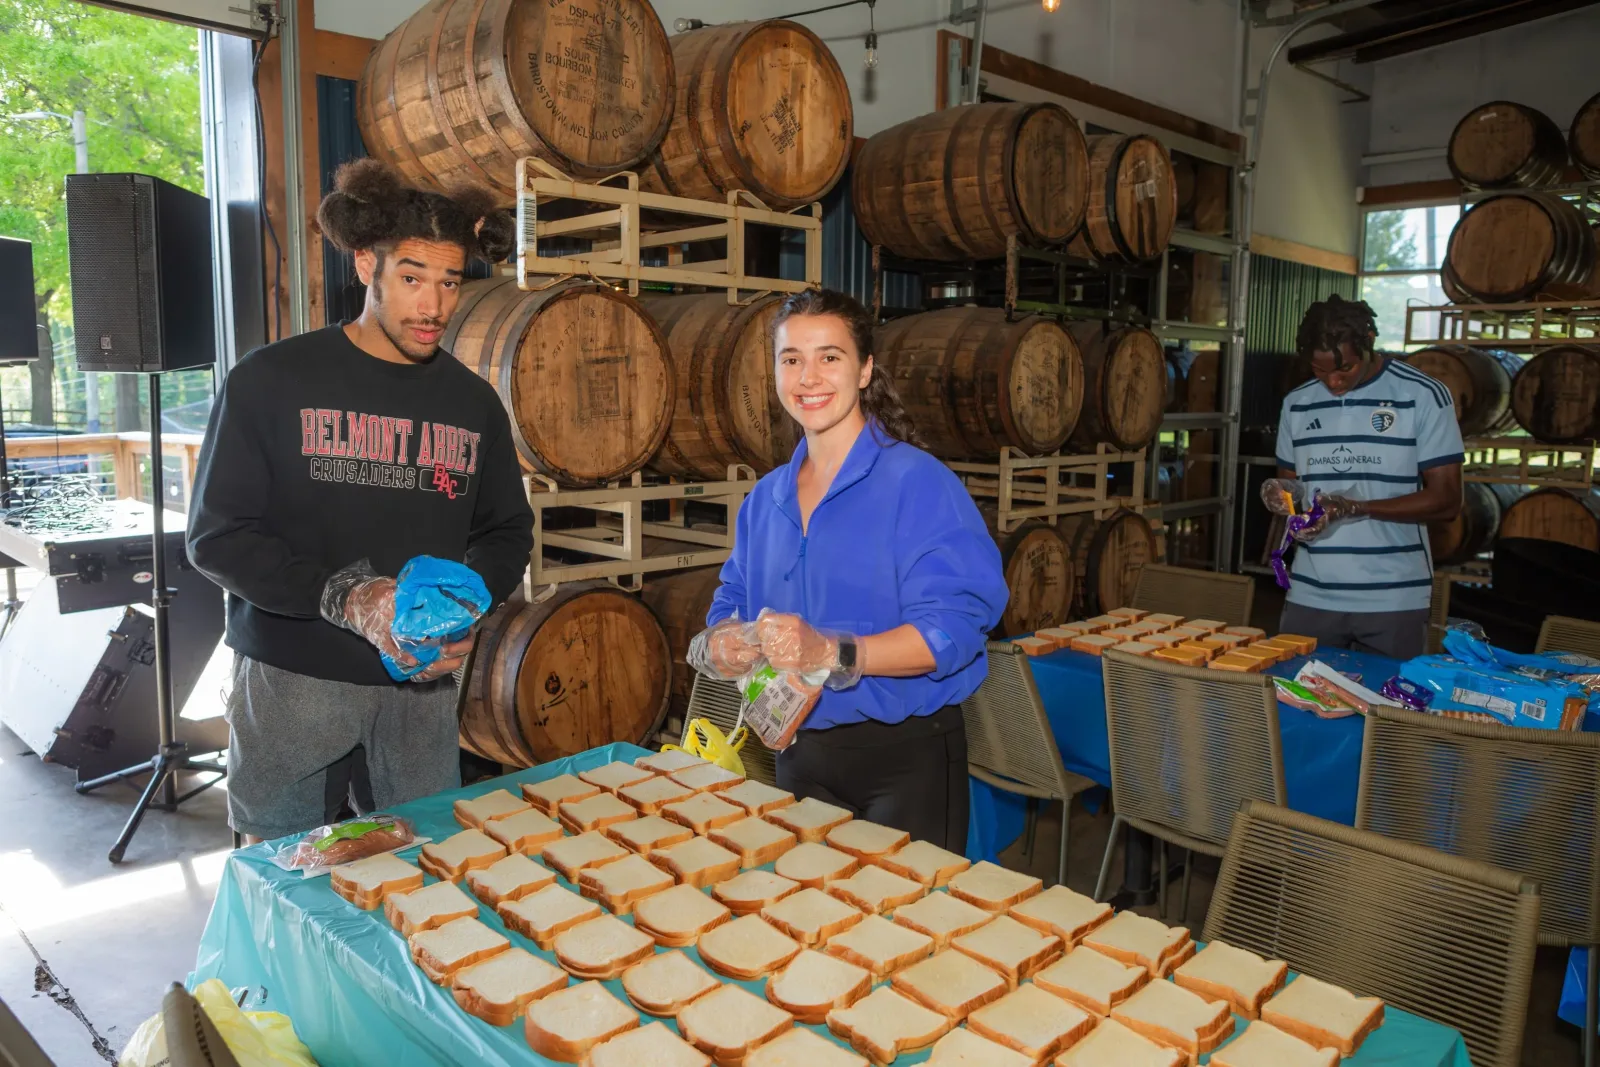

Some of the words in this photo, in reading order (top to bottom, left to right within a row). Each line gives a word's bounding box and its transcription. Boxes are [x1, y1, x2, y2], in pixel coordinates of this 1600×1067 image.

[545, 52, 592, 76] BOURBON
[564, 46, 591, 64] SOUR
[570, 122, 609, 142] NELSON
[300, 408, 413, 465] BELMONT
[417, 421, 482, 474] ABBEY
[1343, 454, 1382, 465] MINERALS
[310, 458, 417, 490] CRUSADERS
[432, 464, 458, 500] BAC
